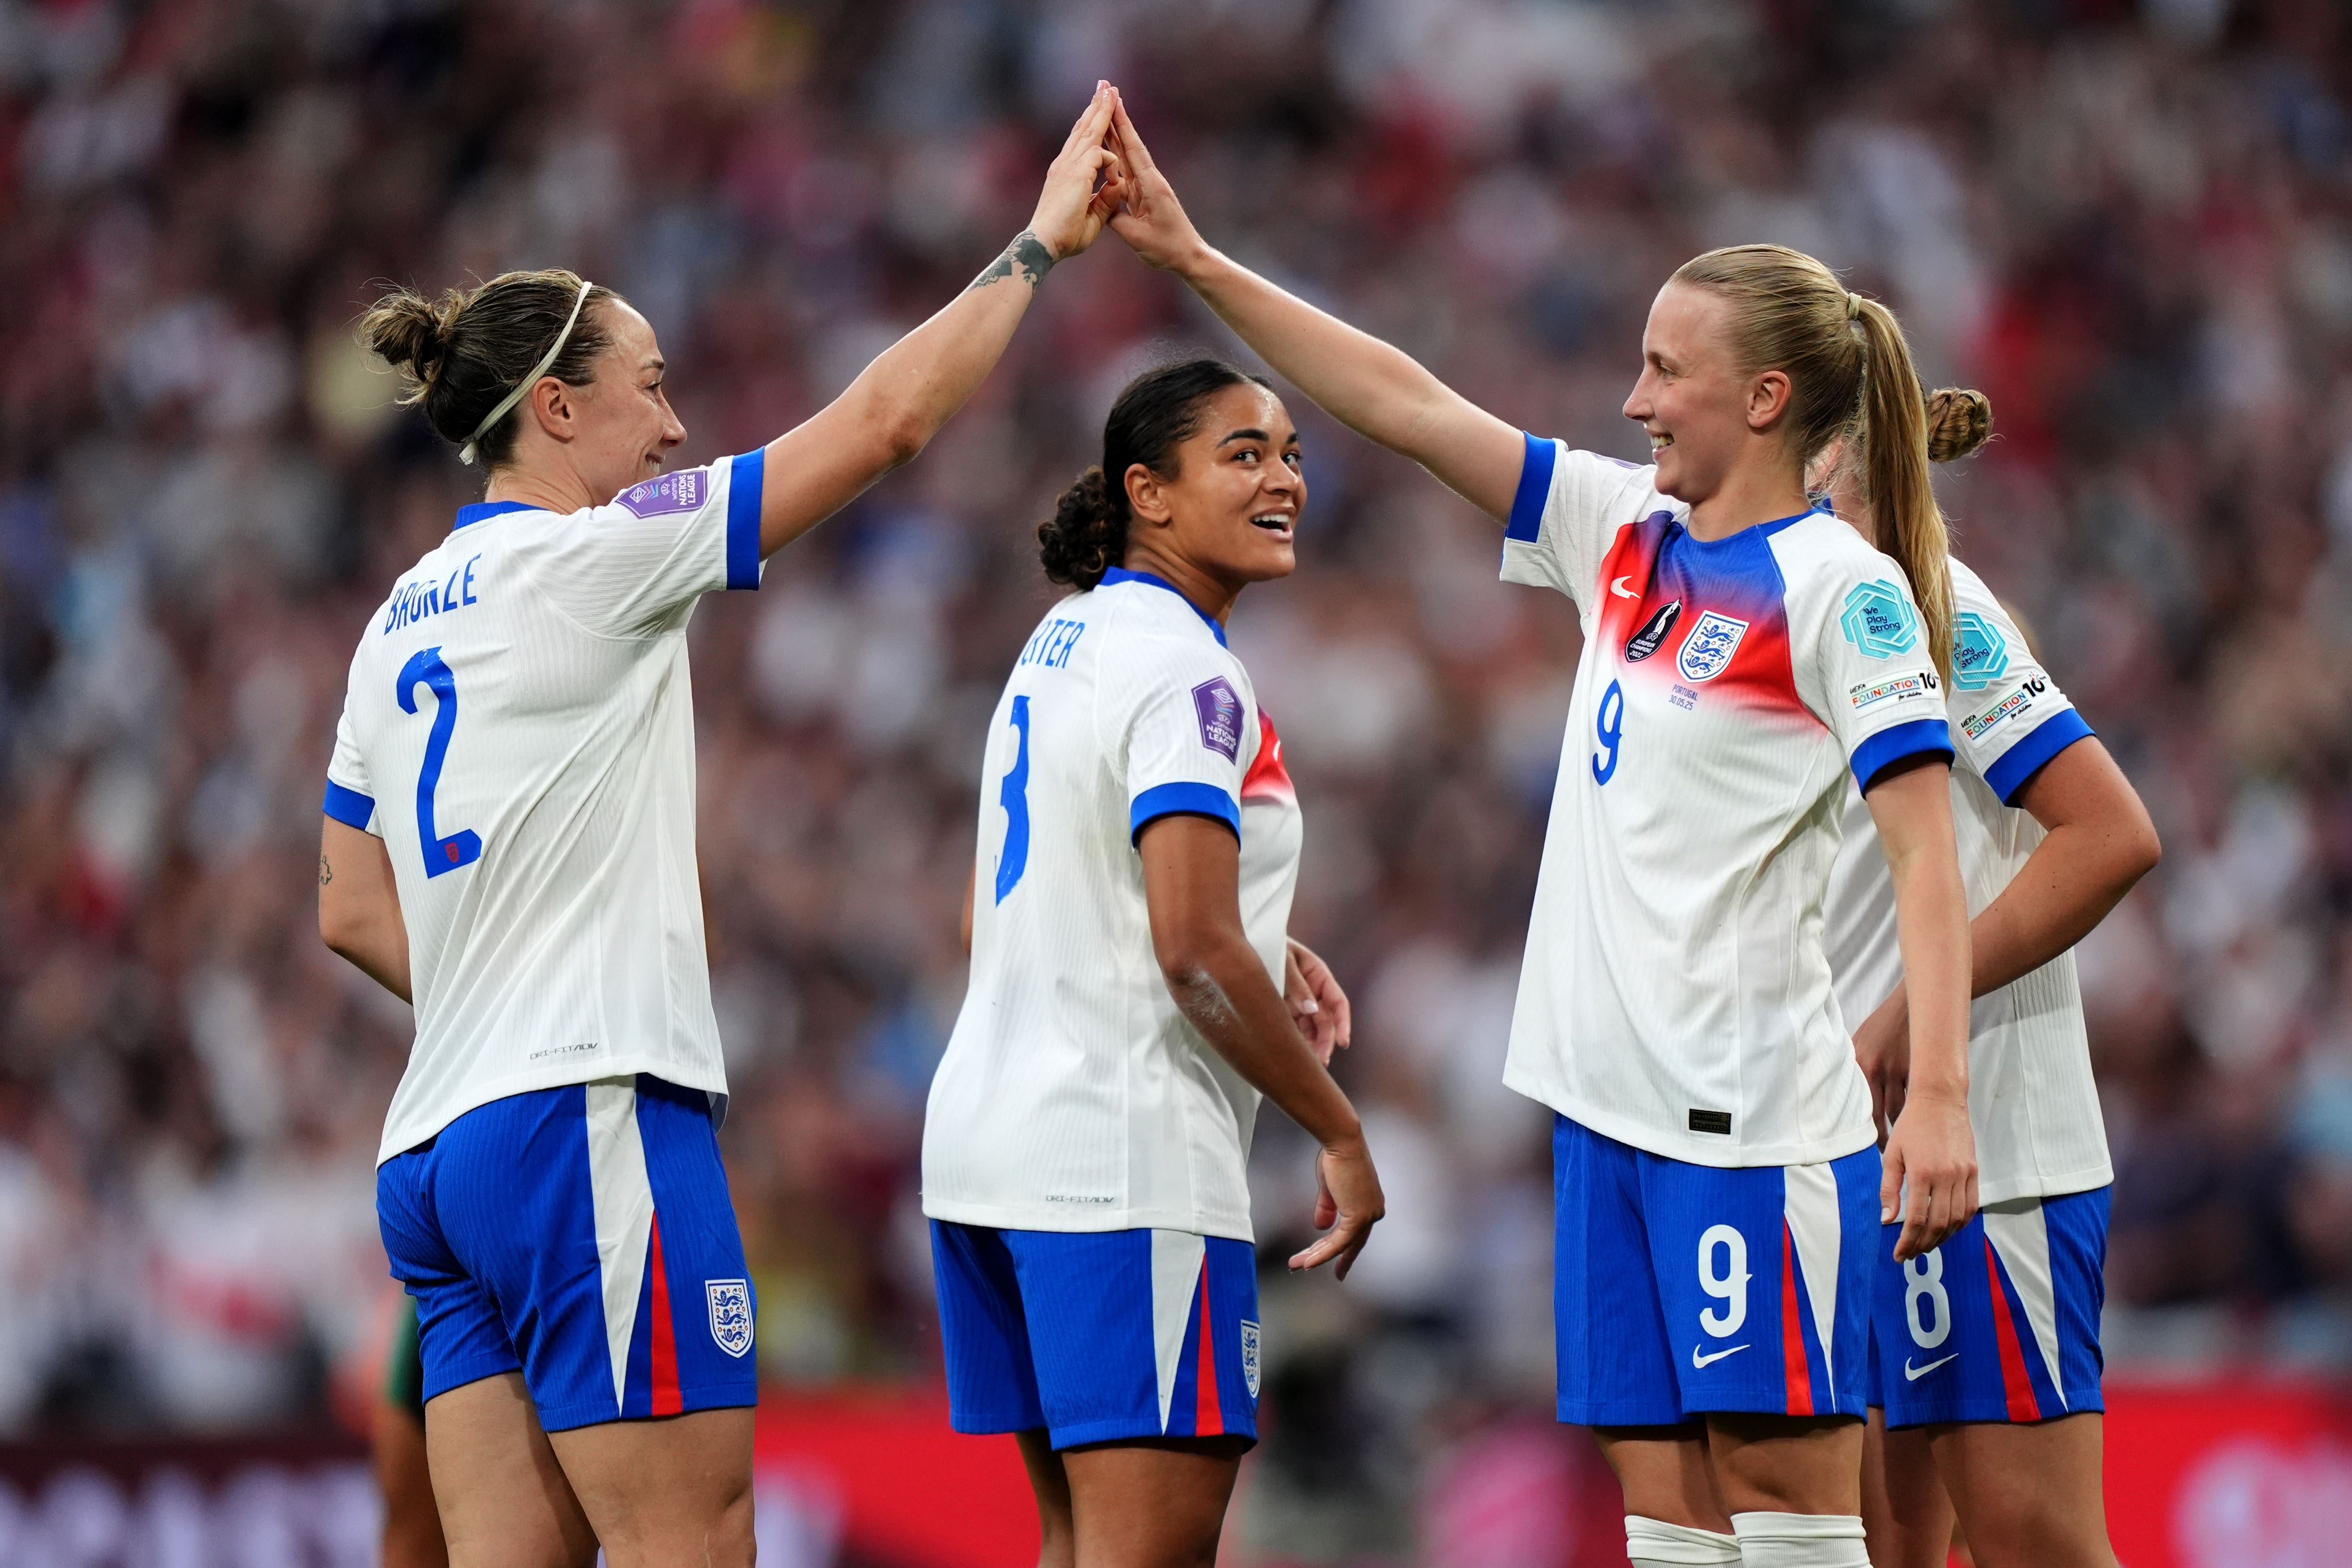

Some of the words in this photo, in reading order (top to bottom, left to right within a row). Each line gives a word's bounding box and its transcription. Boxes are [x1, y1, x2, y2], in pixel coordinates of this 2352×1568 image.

[679, 474, 687, 505] NATIONS
[687, 474, 695, 503] LEAGUE
[1863, 607, 1878, 615] We
[1867, 615, 1887, 625] Play
[1870, 622, 1901, 633] Strong
[1630, 643, 1653, 653] CHAMPIONS
[1635, 639, 1656, 648] EUROPEAN
[1672, 684, 1698, 701] PORTUGAL
[1850, 684, 1866, 694] UEFA
[1852, 679, 1920, 706] FOUNDATION
[2022, 677, 2045, 697] 10
[1669, 695, 1693, 710] 30.05.25
[1961, 715, 1976, 728] UEFA
[1966, 692, 2026, 738] FOUNDATION
[1207, 724, 1236, 746] NATIONS
[1209, 732, 1235, 753] LEAGUE
[1592, 678, 1623, 786] 9
[397, 646, 482, 879] 2
[996, 695, 1031, 908] 3
[1698, 1224, 1753, 1337] 9
[1904, 1247, 1951, 1349] 8
